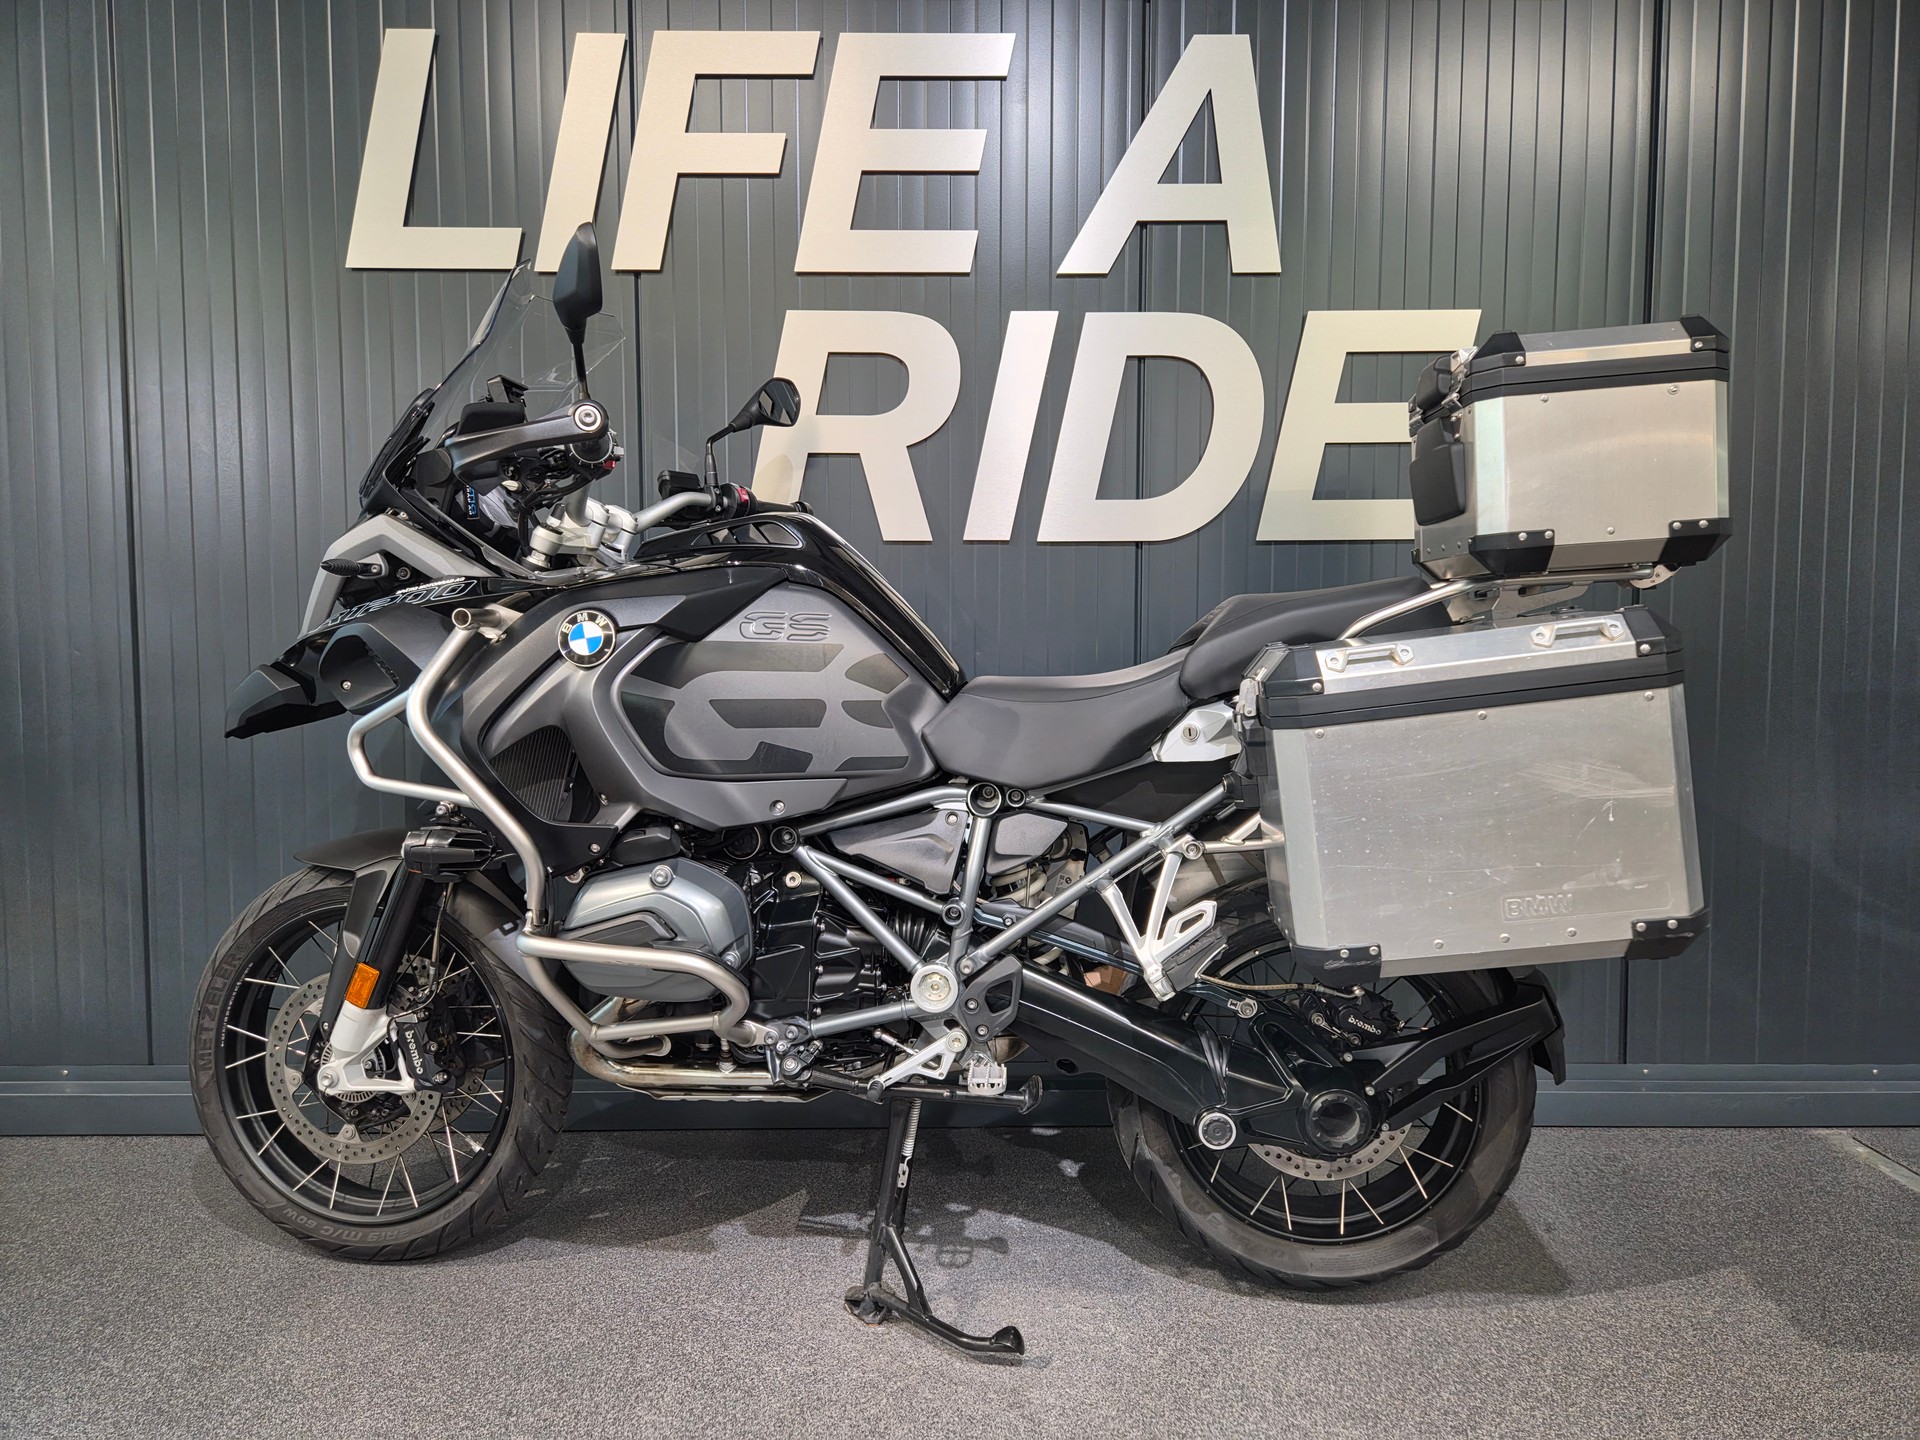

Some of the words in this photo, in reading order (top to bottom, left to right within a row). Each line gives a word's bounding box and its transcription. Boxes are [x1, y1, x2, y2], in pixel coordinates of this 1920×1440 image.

[345, 28, 1016, 274] LIFE
[1056, 34, 1281, 276] A
[752, 309, 1481, 543] RIDE
[561, 612, 608, 634] BMW
[739, 611, 832, 642] GS
[1504, 893, 1573, 919] BMW
[1348, 1015, 1382, 1035] brembo
[404, 1030, 424, 1075] brembo
